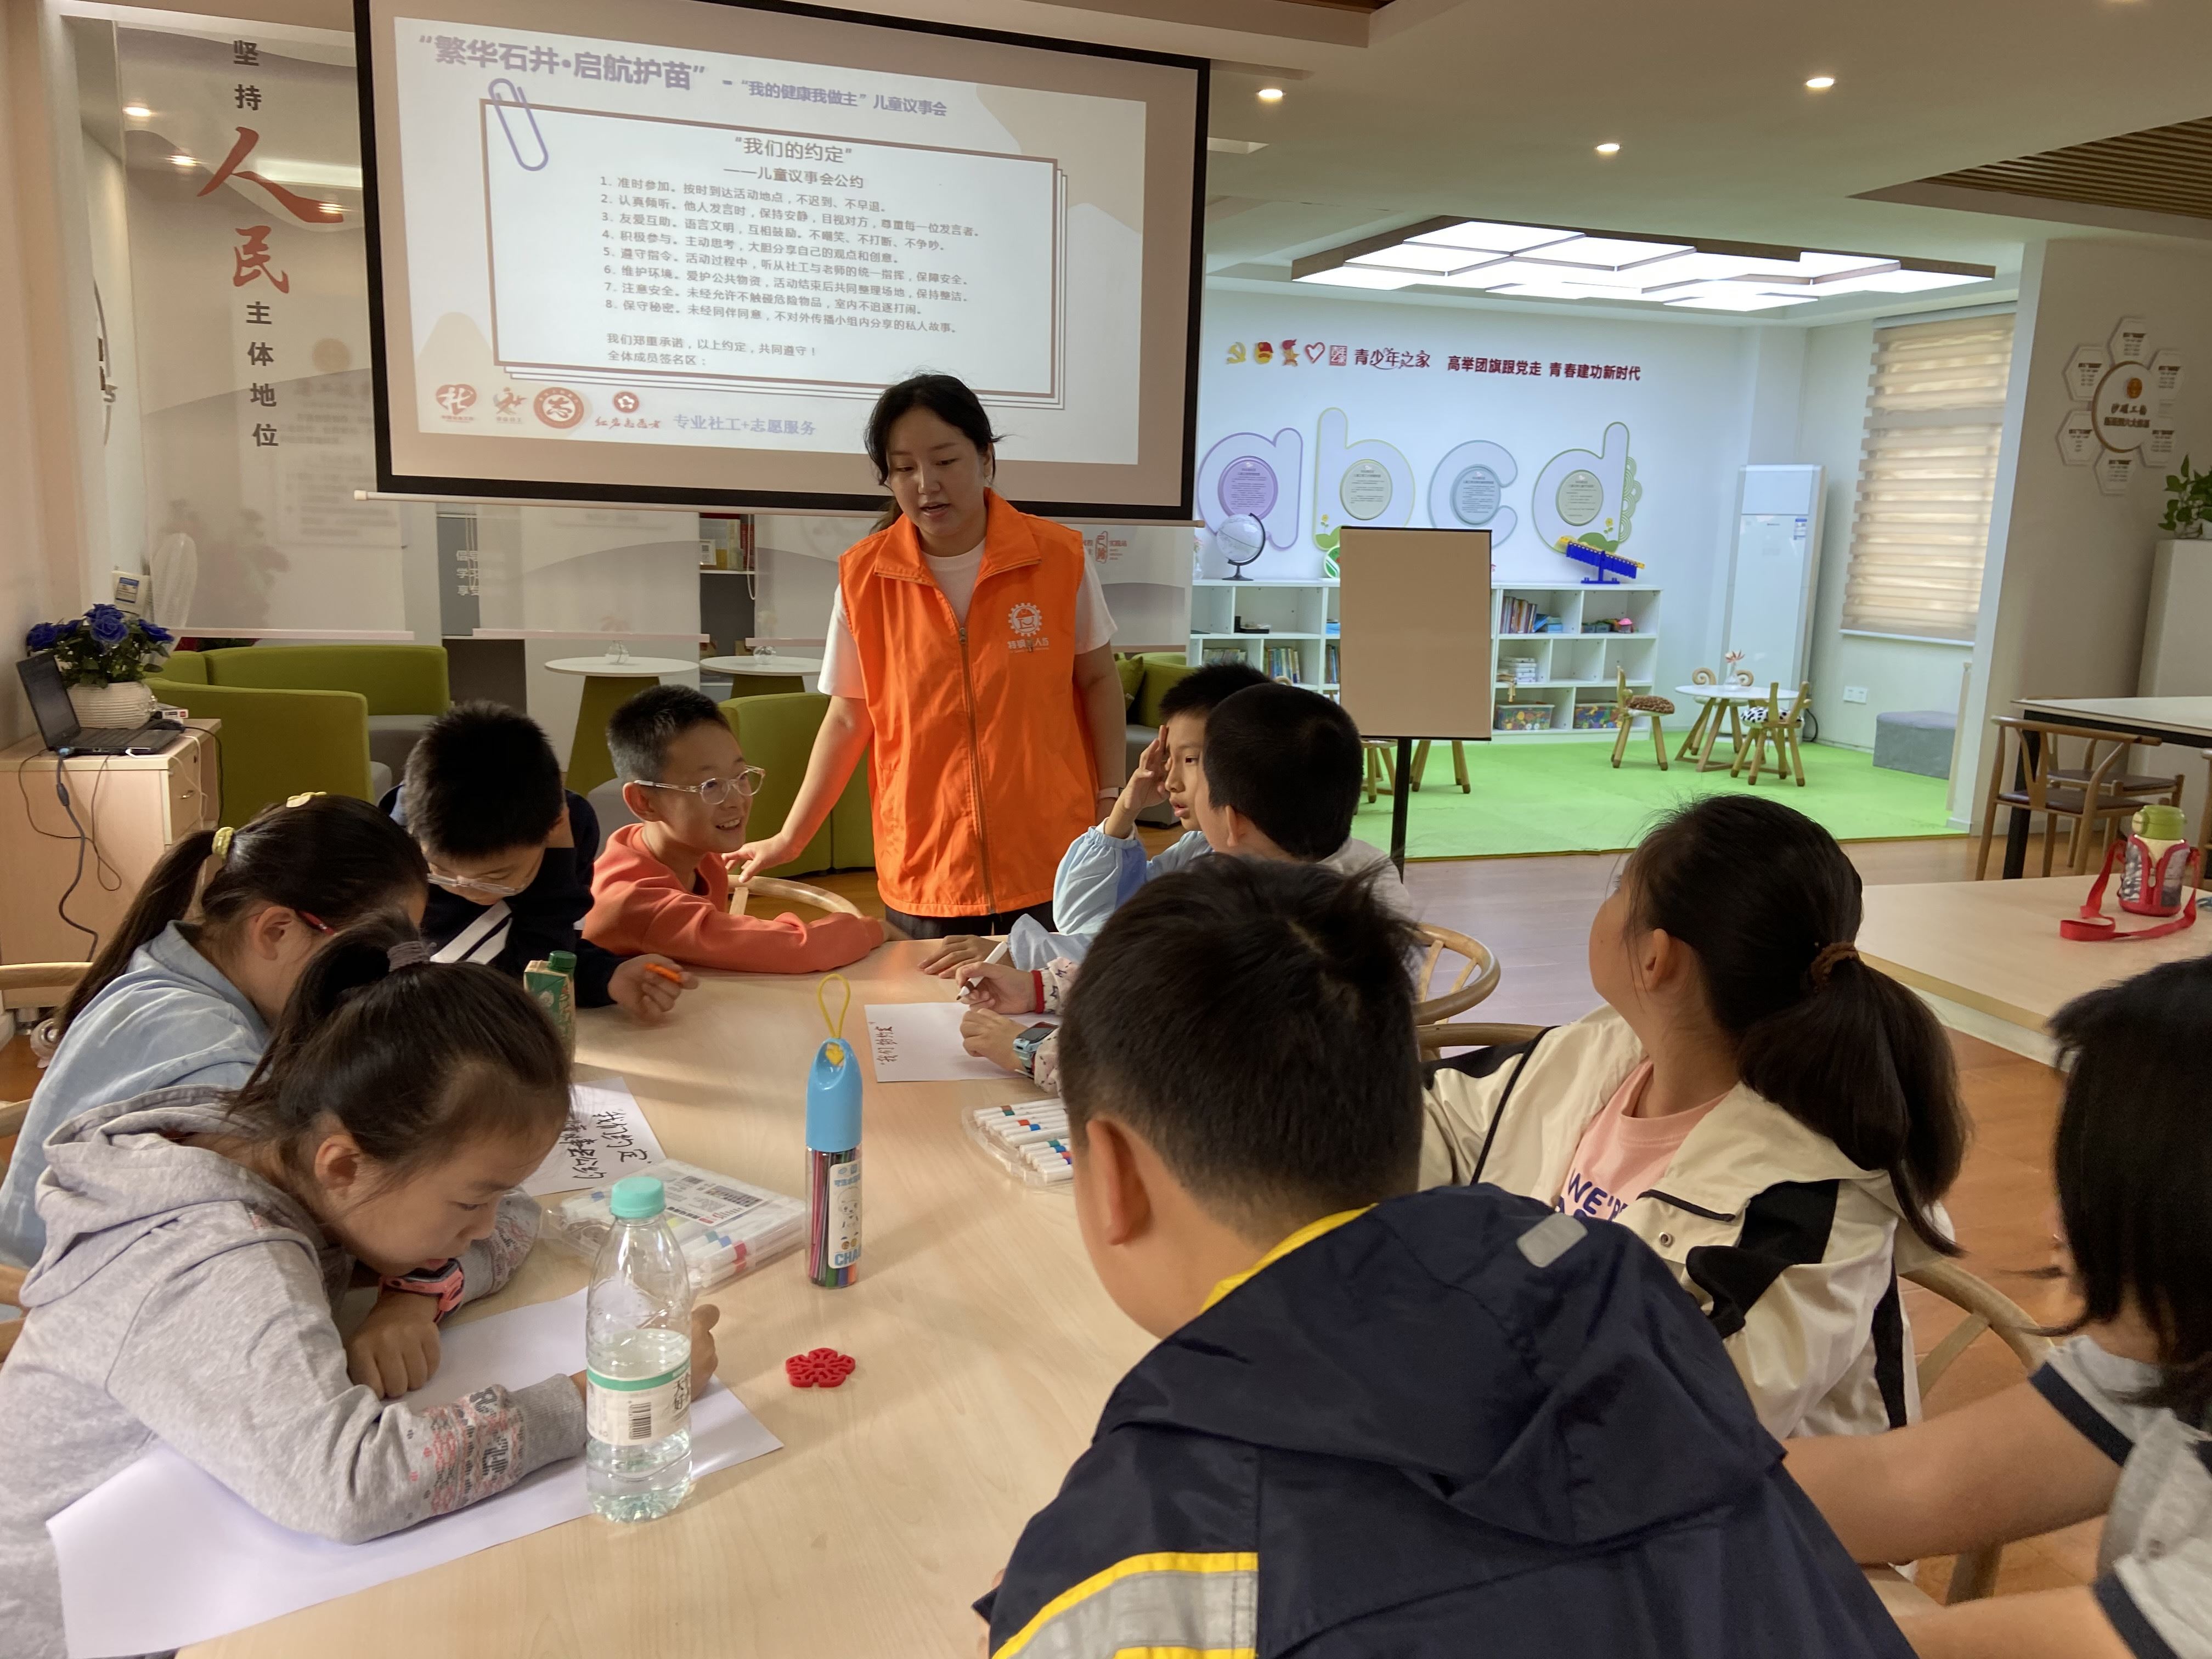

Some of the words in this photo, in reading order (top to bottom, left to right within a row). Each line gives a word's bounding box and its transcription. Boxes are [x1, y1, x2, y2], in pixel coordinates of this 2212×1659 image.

[873, 95, 947, 117] 儿童议事会
[735, 137, 852, 164] “我们的约定”
[1355, 347, 1431, 370] 青少年之家
[1448, 356, 1542, 376] 高举团旗跟党走
[1549, 362, 1641, 381] 青春建功新时代
[673, 414, 816, 436] 专业社工+志愿服务
